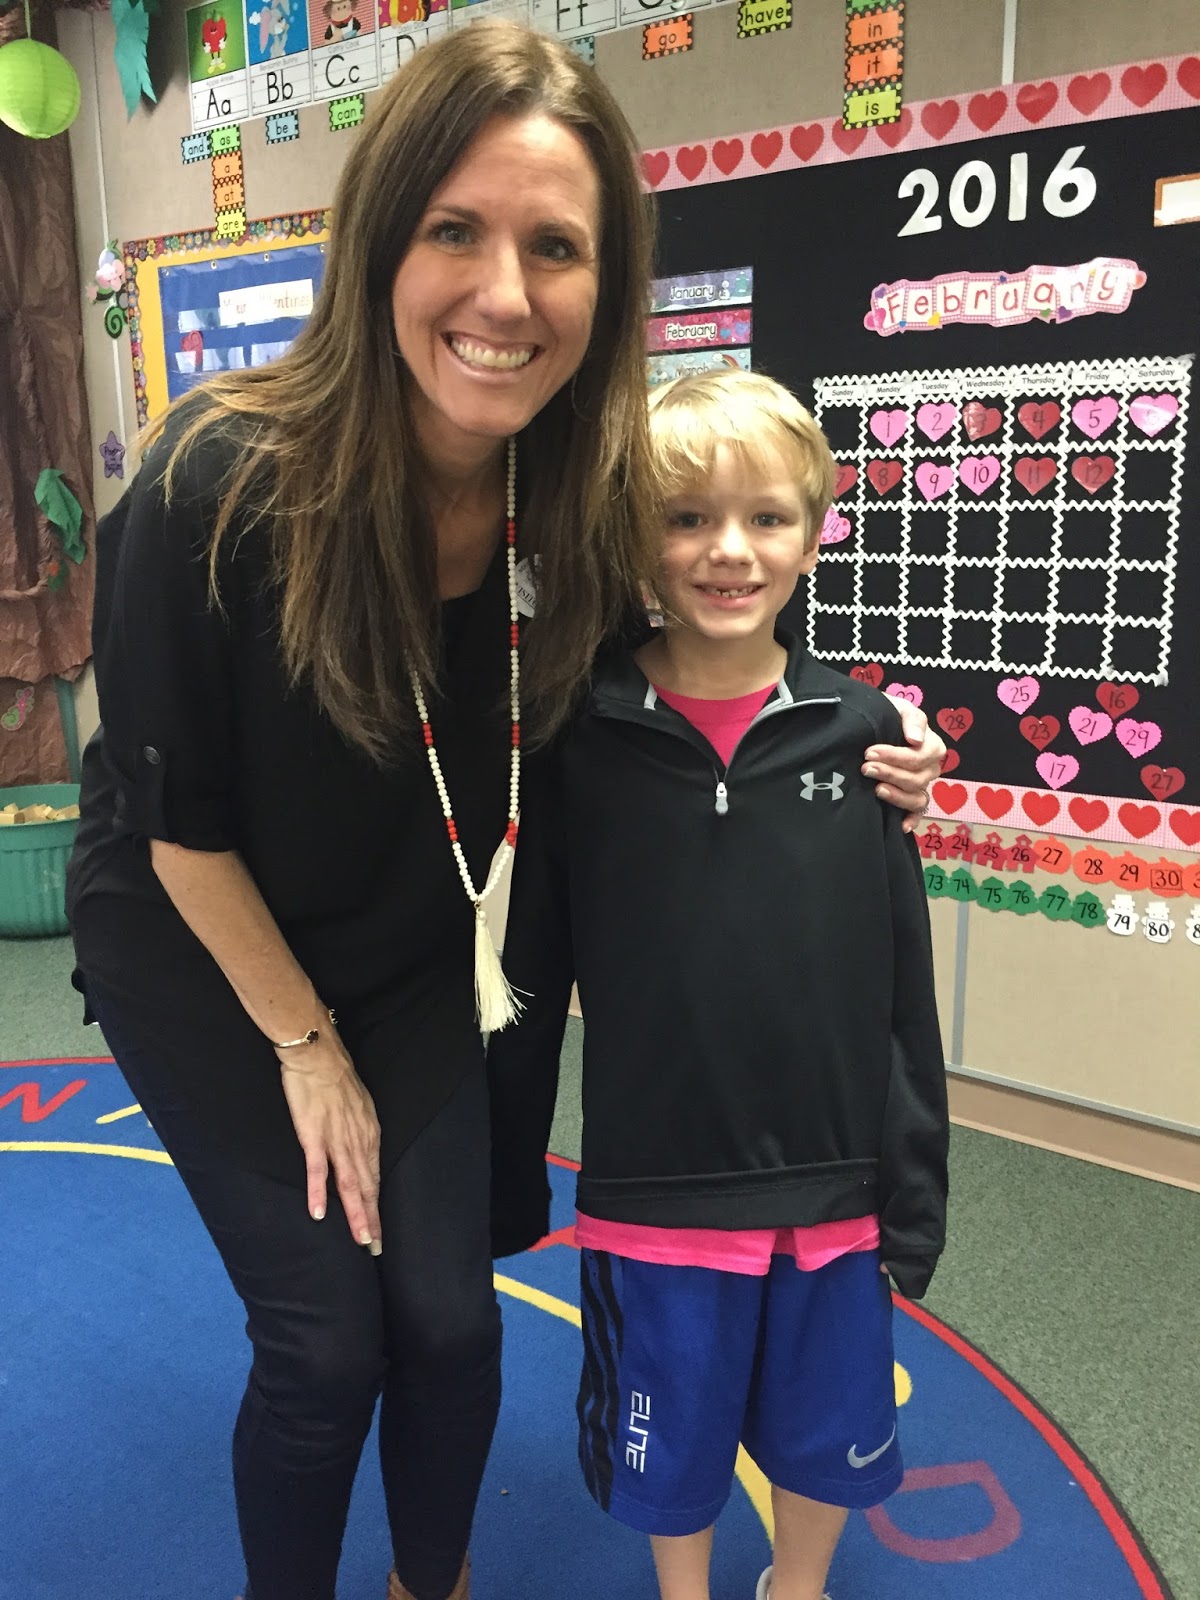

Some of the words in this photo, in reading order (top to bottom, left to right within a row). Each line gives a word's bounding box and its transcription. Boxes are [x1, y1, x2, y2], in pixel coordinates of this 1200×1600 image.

[744, 7, 785, 26] have
[867, 23, 883, 37] in
[658, 33, 677, 50] go
[325, 54, 360, 88] Cc
[866, 56, 881, 75] it
[266, 69, 294, 104] Bb
[206, 88, 233, 119] Aa
[337, 107, 357, 119] can
[865, 101, 880, 116] is
[275, 122, 289, 135] be
[187, 143, 204, 155] and
[219, 135, 231, 146] as
[223, 164, 231, 174] a
[223, 189, 235, 202] at
[897, 145, 1097, 237] 2016
[222, 217, 240, 230] are
[670, 285, 715, 299] January
[886, 269, 1118, 323] February
[666, 325, 716, 339] February
[876, 386, 901, 394] Monday
[921, 383, 949, 391] Tuesday
[966, 378, 1006, 388] Wednesday
[1022, 376, 1056, 385] Thursday
[1085, 372, 1110, 382] Friday
[1138, 367, 1175, 379] Saturday
[931, 412, 943, 432] 2
[1032, 410, 1045, 430] 4
[1088, 408, 1102, 429] 5
[877, 467, 889, 487] 8
[929, 473, 940, 494] 9
[973, 465, 990, 486] 10
[1085, 464, 1104, 485] 12
[1010, 685, 1030, 704] 25
[1109, 691, 1127, 709] 16
[945, 715, 966, 732] 28
[1028, 723, 1051, 741] 23
[1078, 717, 1098, 737] 21
[1125, 728, 1150, 750] 29
[1049, 761, 1067, 780] 17
[1150, 773, 1174, 793] 27
[925, 834, 943, 850] 23
[952, 836, 970, 852] 24
[983, 845, 1000, 859] 25
[1011, 847, 1030, 863] 26
[1042, 847, 1063, 866] 27
[1084, 858, 1104, 876] 28
[1119, 864, 1139, 882] 29
[1155, 869, 1180, 887] 30
[927, 874, 944, 891] 73
[953, 878, 970, 895] 74
[984, 887, 1001, 904] 75
[1012, 890, 1030, 905] 76
[1046, 893, 1066, 911] 77
[1076, 902, 1098, 919] 78
[1113, 913, 1131, 930] 79
[1148, 921, 1170, 937] 80
[626, 1390, 650, 1473] ELITE
